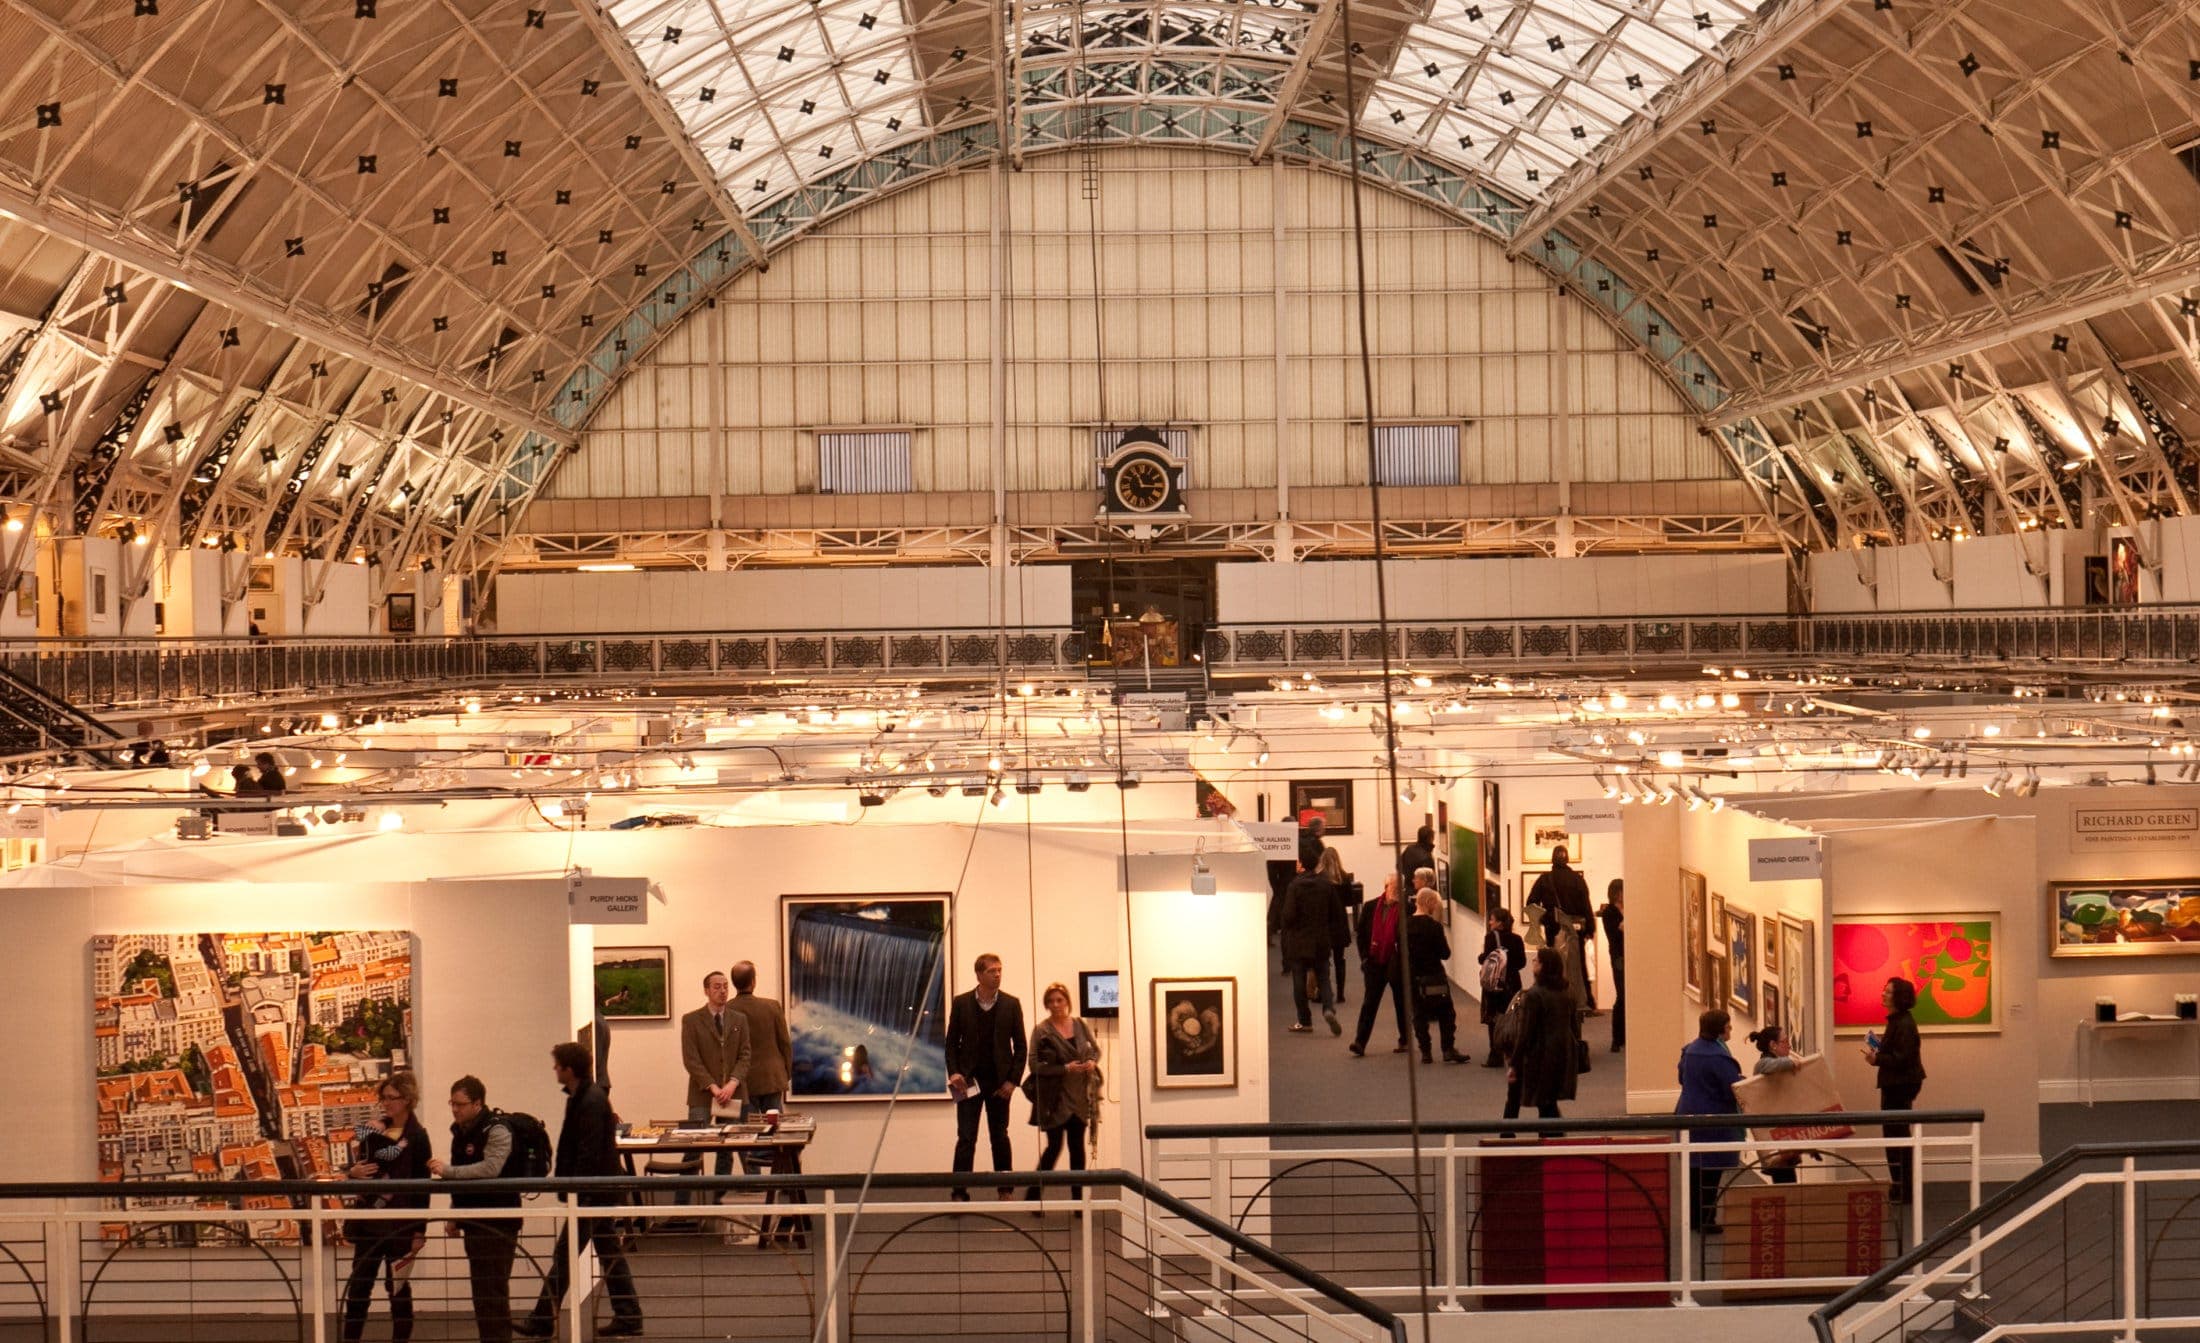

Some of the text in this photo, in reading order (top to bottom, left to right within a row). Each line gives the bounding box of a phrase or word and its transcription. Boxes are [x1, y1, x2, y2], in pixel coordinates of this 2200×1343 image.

[2083, 814, 2192, 826] RICHARD GREEN
[1757, 855, 1810, 864] RICHARD GREEN
[589, 895, 639, 903] PURDY HICKS
[607, 904, 639, 912] GALLERY
